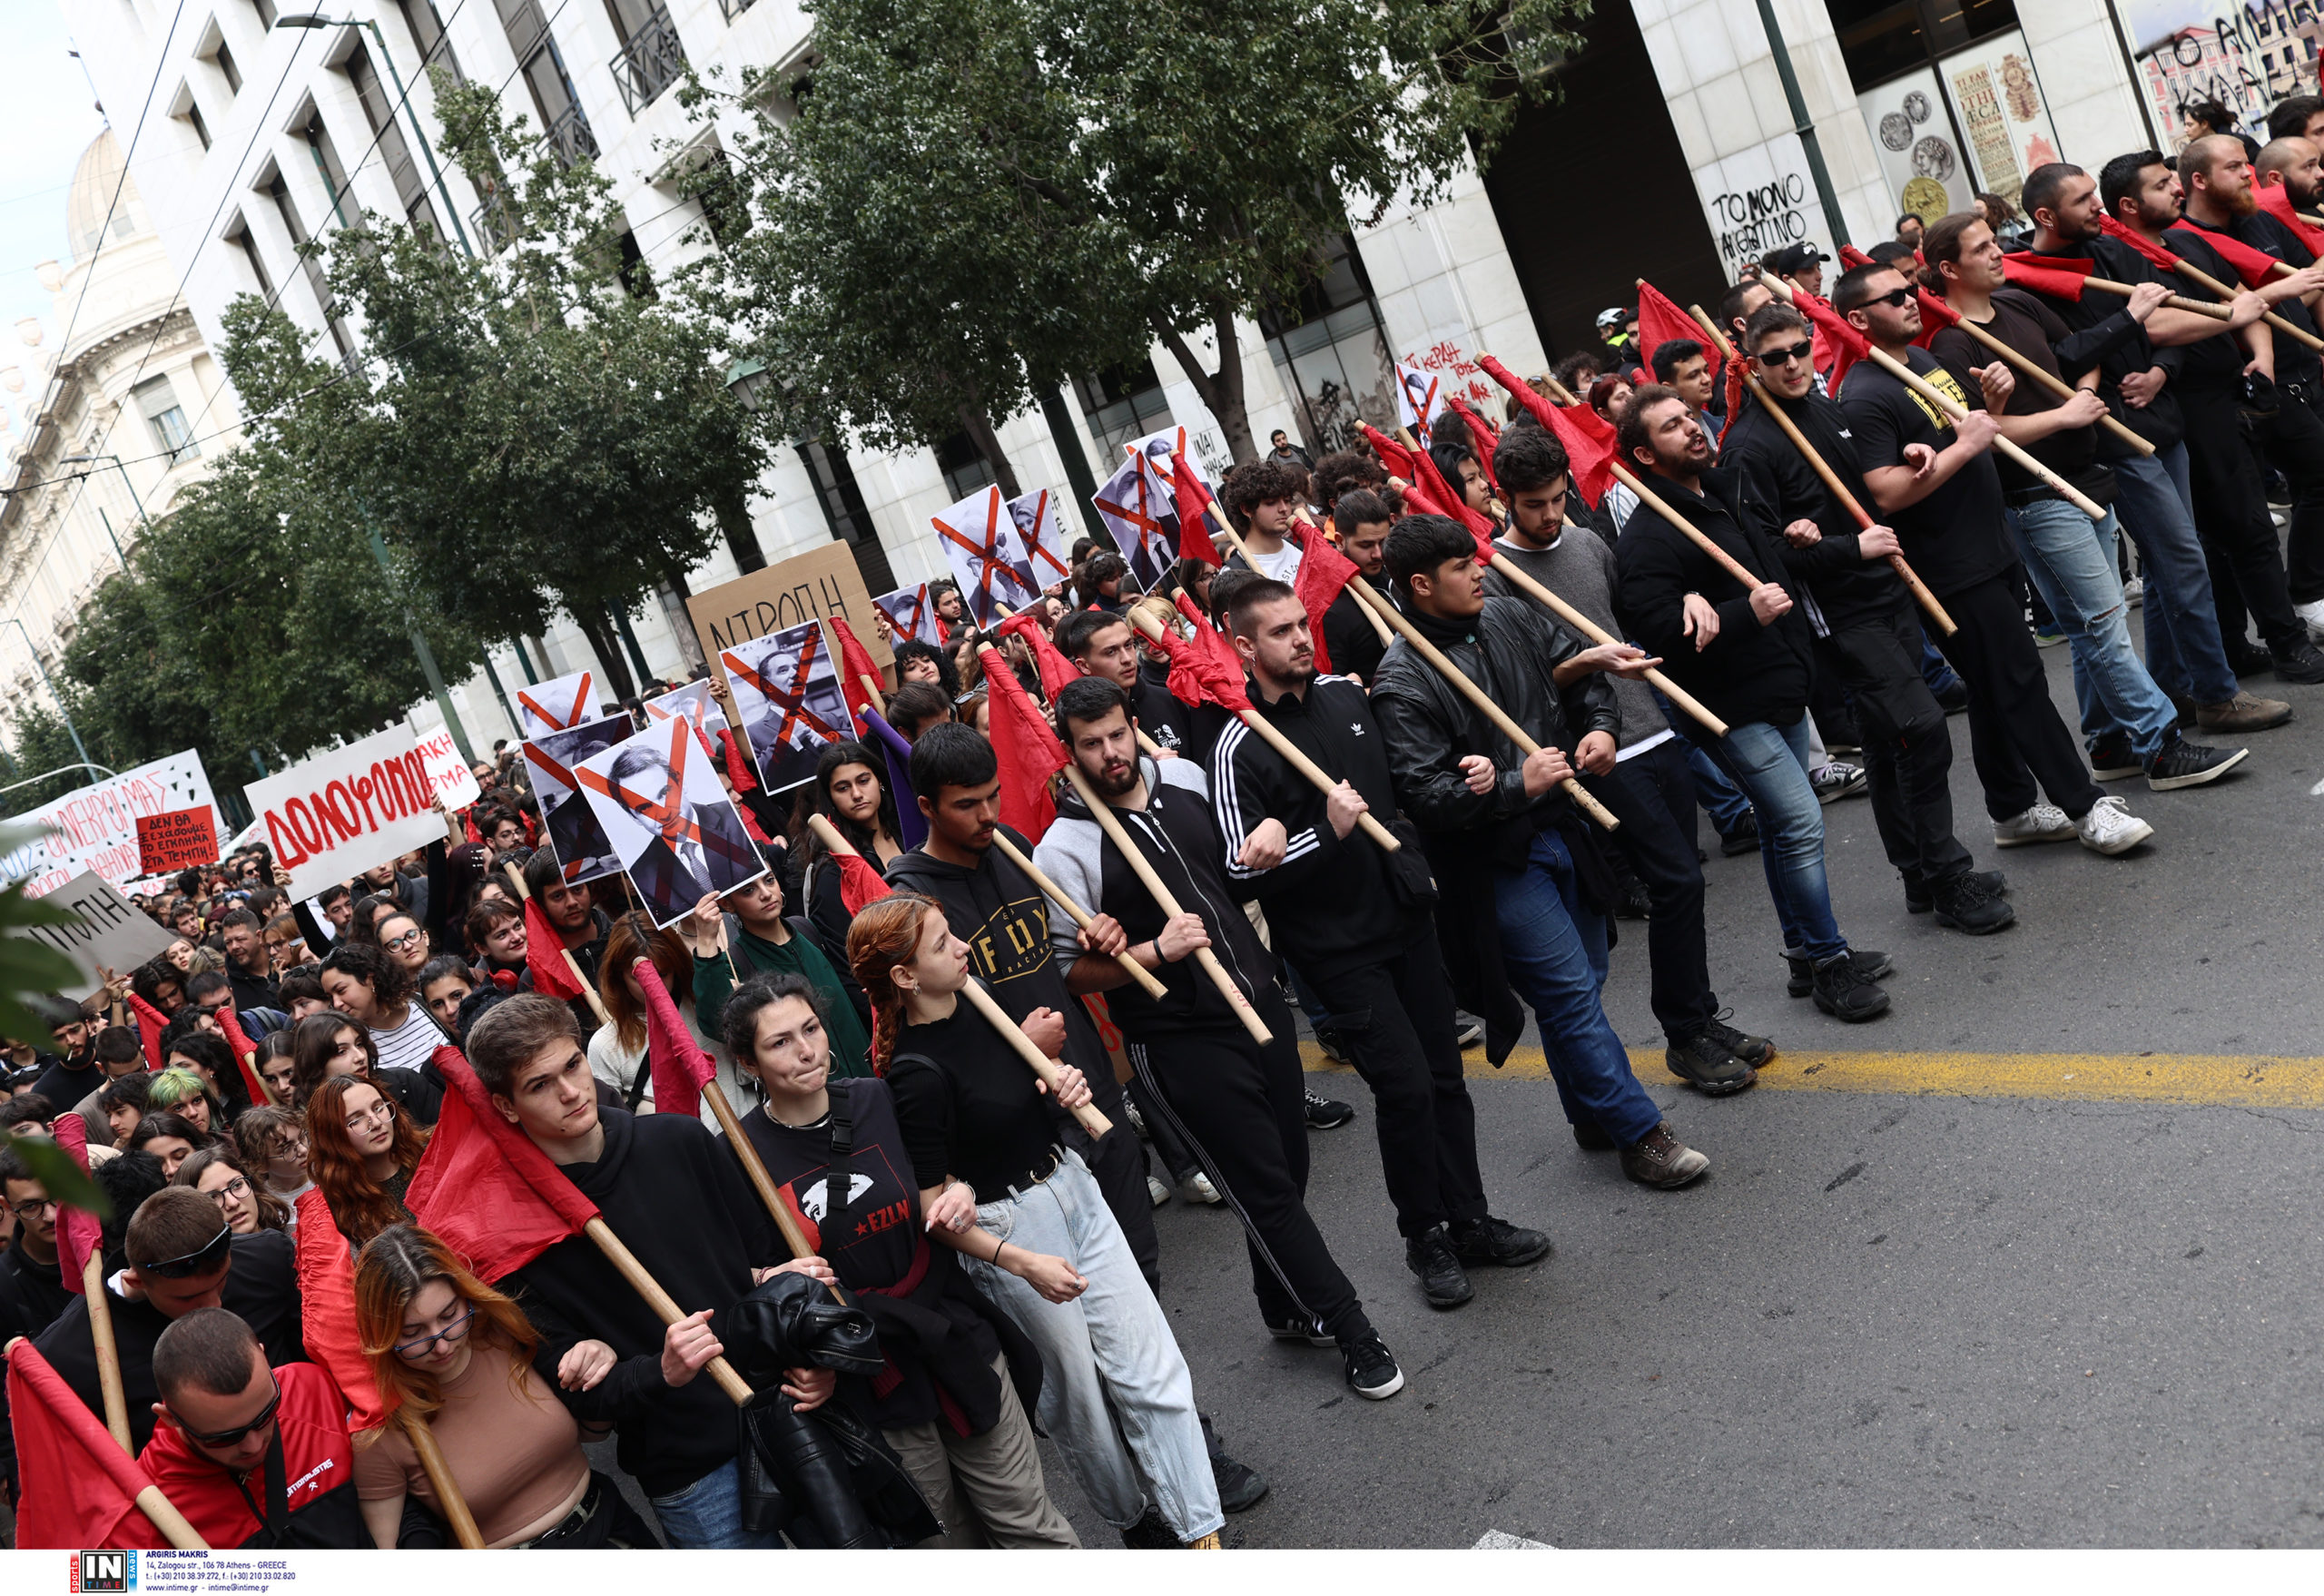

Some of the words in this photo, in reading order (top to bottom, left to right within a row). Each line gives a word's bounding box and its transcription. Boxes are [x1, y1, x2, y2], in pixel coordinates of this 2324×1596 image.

[1712, 193, 1746, 227] ΤΟ
[1747, 173, 1804, 222] ΜΟΝΟ
[1193, 431, 1216, 458] ΙΝΑΙ
[419, 733, 454, 763] ΑΚΗ
[428, 764, 468, 793] ΡΜΑ
[57, 787, 129, 850] ΝΕΚΡΟΙ
[121, 771, 165, 817] ΜΑΣ
[149, 816, 172, 831] ΔΕΝ
[174, 813, 192, 827] ΘΑ
[140, 842, 154, 854] ΤΟ
[867, 1199, 911, 1232] EZLN
